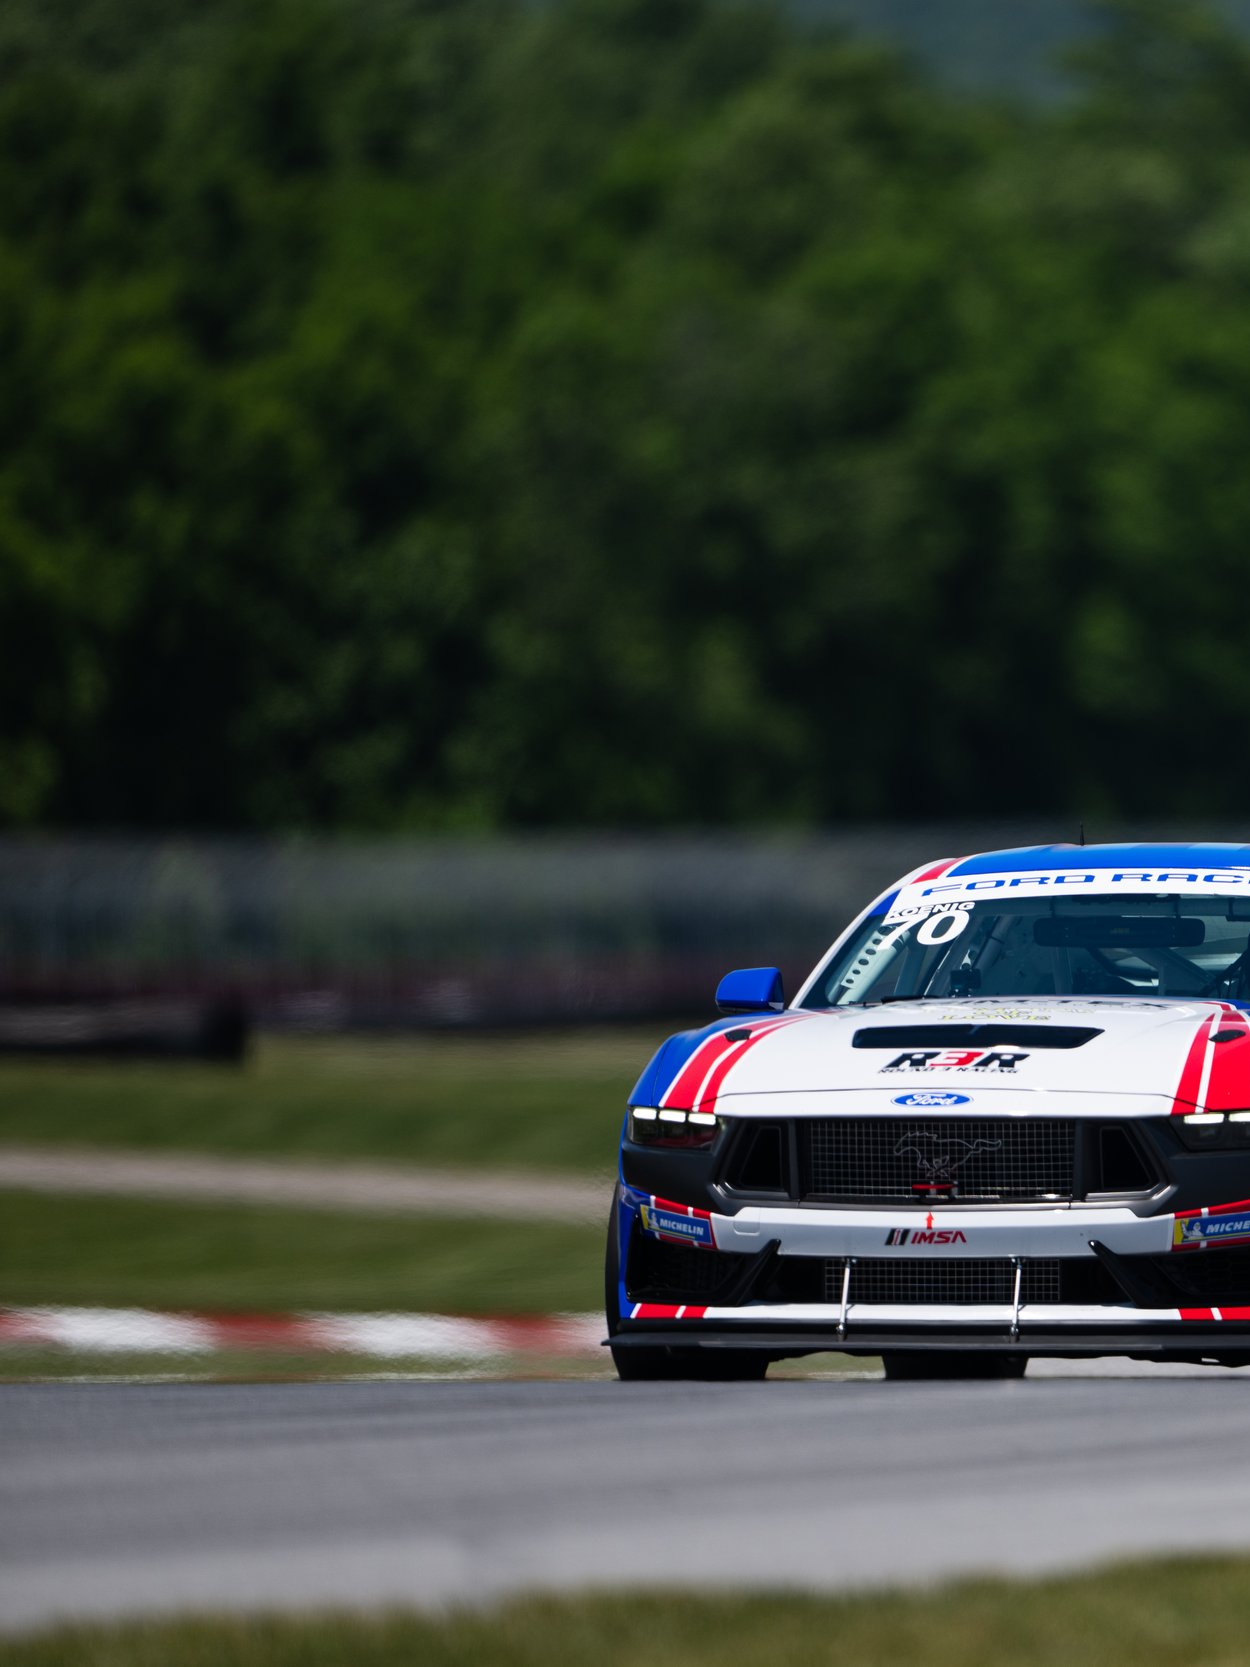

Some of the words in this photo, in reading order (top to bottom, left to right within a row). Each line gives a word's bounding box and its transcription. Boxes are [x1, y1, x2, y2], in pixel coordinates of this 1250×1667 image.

[921, 874, 1095, 897] FORD
[888, 902, 976, 919] KOENIG
[877, 910, 970, 950] 70
[884, 1051, 1031, 1068] R3R
[905, 1093, 958, 1106] Ford
[660, 1218, 704, 1236] MICHELIN
[911, 1230, 967, 1244] IMSA
